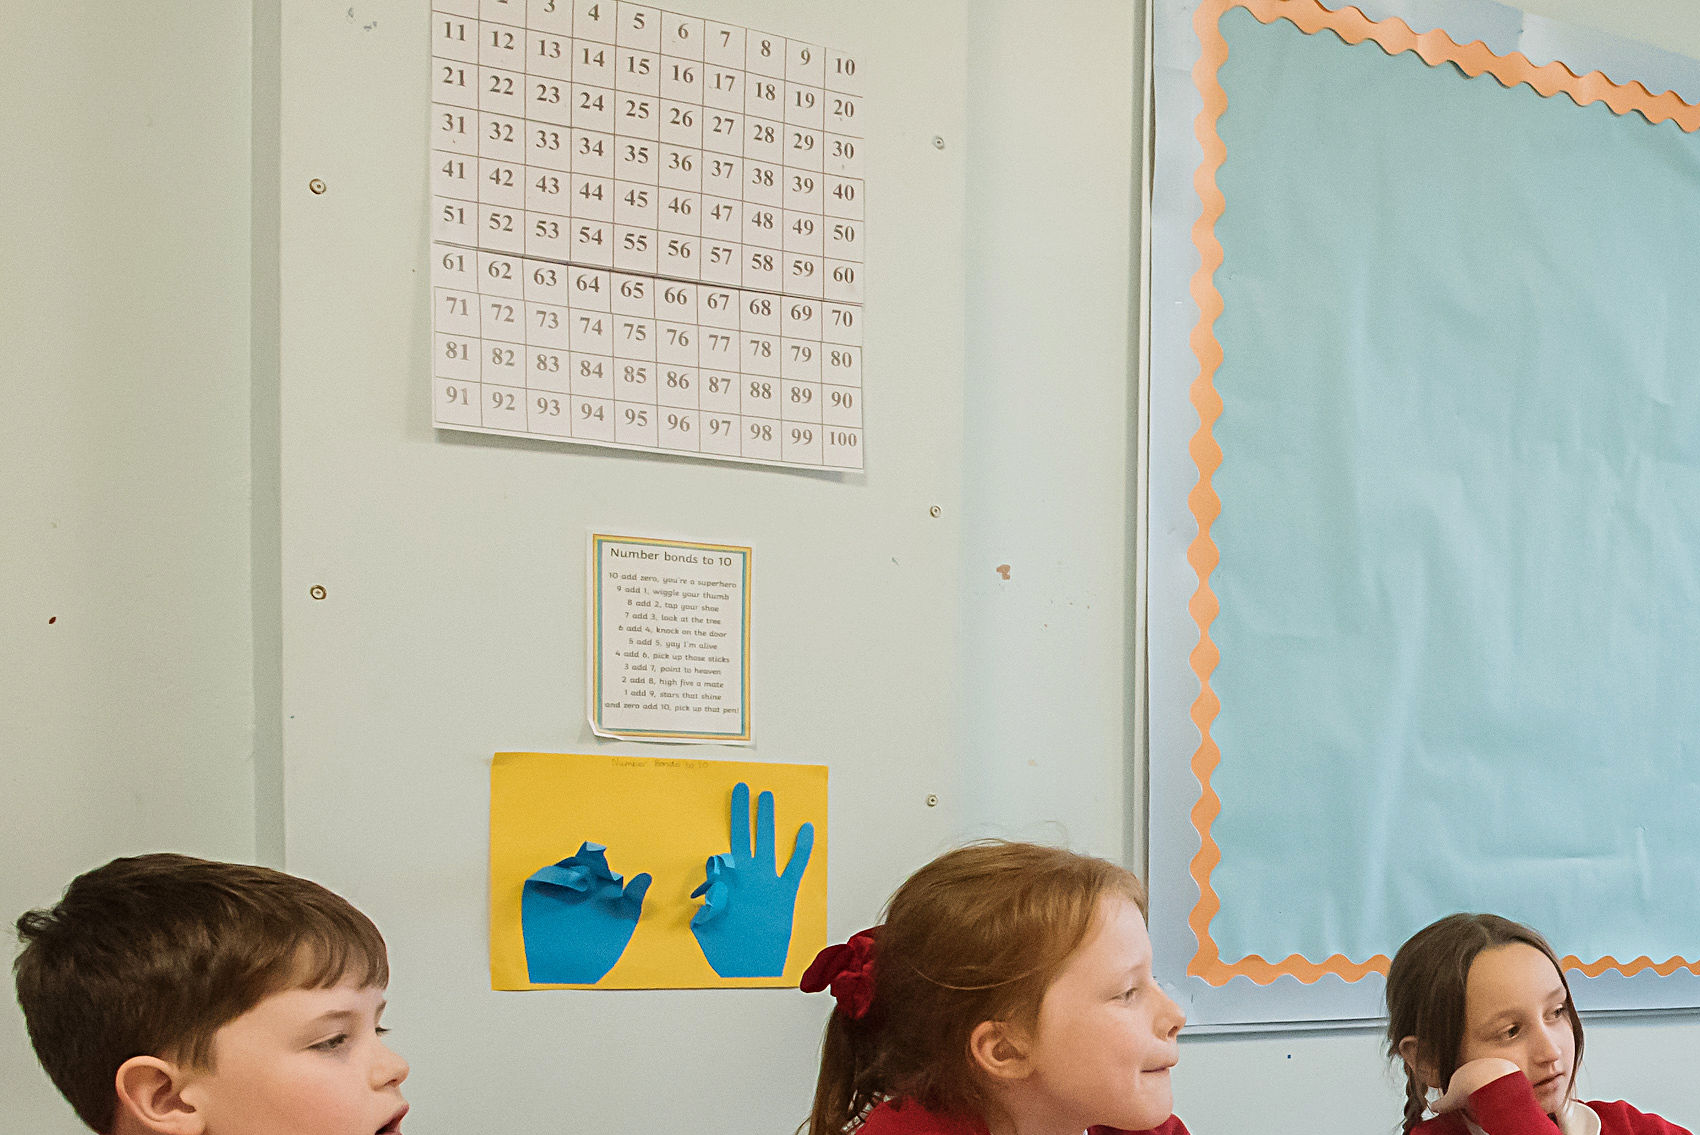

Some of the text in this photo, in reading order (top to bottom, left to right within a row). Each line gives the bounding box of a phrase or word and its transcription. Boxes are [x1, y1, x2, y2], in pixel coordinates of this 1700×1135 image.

[445, 22, 854, 117] 11 12 13 14 15 16 17 18 19 20
[544, 0, 855, 76] 3 4 5 6 7 8 9 10
[443, 66, 854, 159] 21 22 23 24 25 26 27 28 29 30
[442, 113, 854, 201] 31 32 33 34 35 36 37 38 39 40
[442, 160, 854, 242] 41 42 43 44 45 46 47 48 49 50
[444, 205, 854, 284] 51 52 53 54 55 56 57 58 59 60
[442, 253, 853, 327] 61 62 63 64 65 66 67 68 69 70
[446, 296, 852, 368] 71 72 73 74 75 76 77 78 79 80
[445, 341, 852, 408] 81 82 83 84 85 86 87 88 89 90
[446, 386, 857, 446] 91 92 93 94 95 96 97 98 99 100
[610, 548, 732, 567] Number bonds to 10
[620, 573, 637, 581] add
[624, 586, 641, 594] add
[652, 589, 679, 598] wiggle
[629, 676, 646, 684] add
[659, 678, 678, 688] high
[679, 678, 694, 688] five
[630, 689, 646, 697] add
[682, 692, 698, 700] that
[701, 693, 722, 701] shine
[660, 666, 681, 674] point
[694, 667, 722, 675] heaven
[604, 702, 621, 710] and
[642, 702, 658, 710] add
[704, 705, 720, 713] that
[722, 706, 740, 715] pen!
